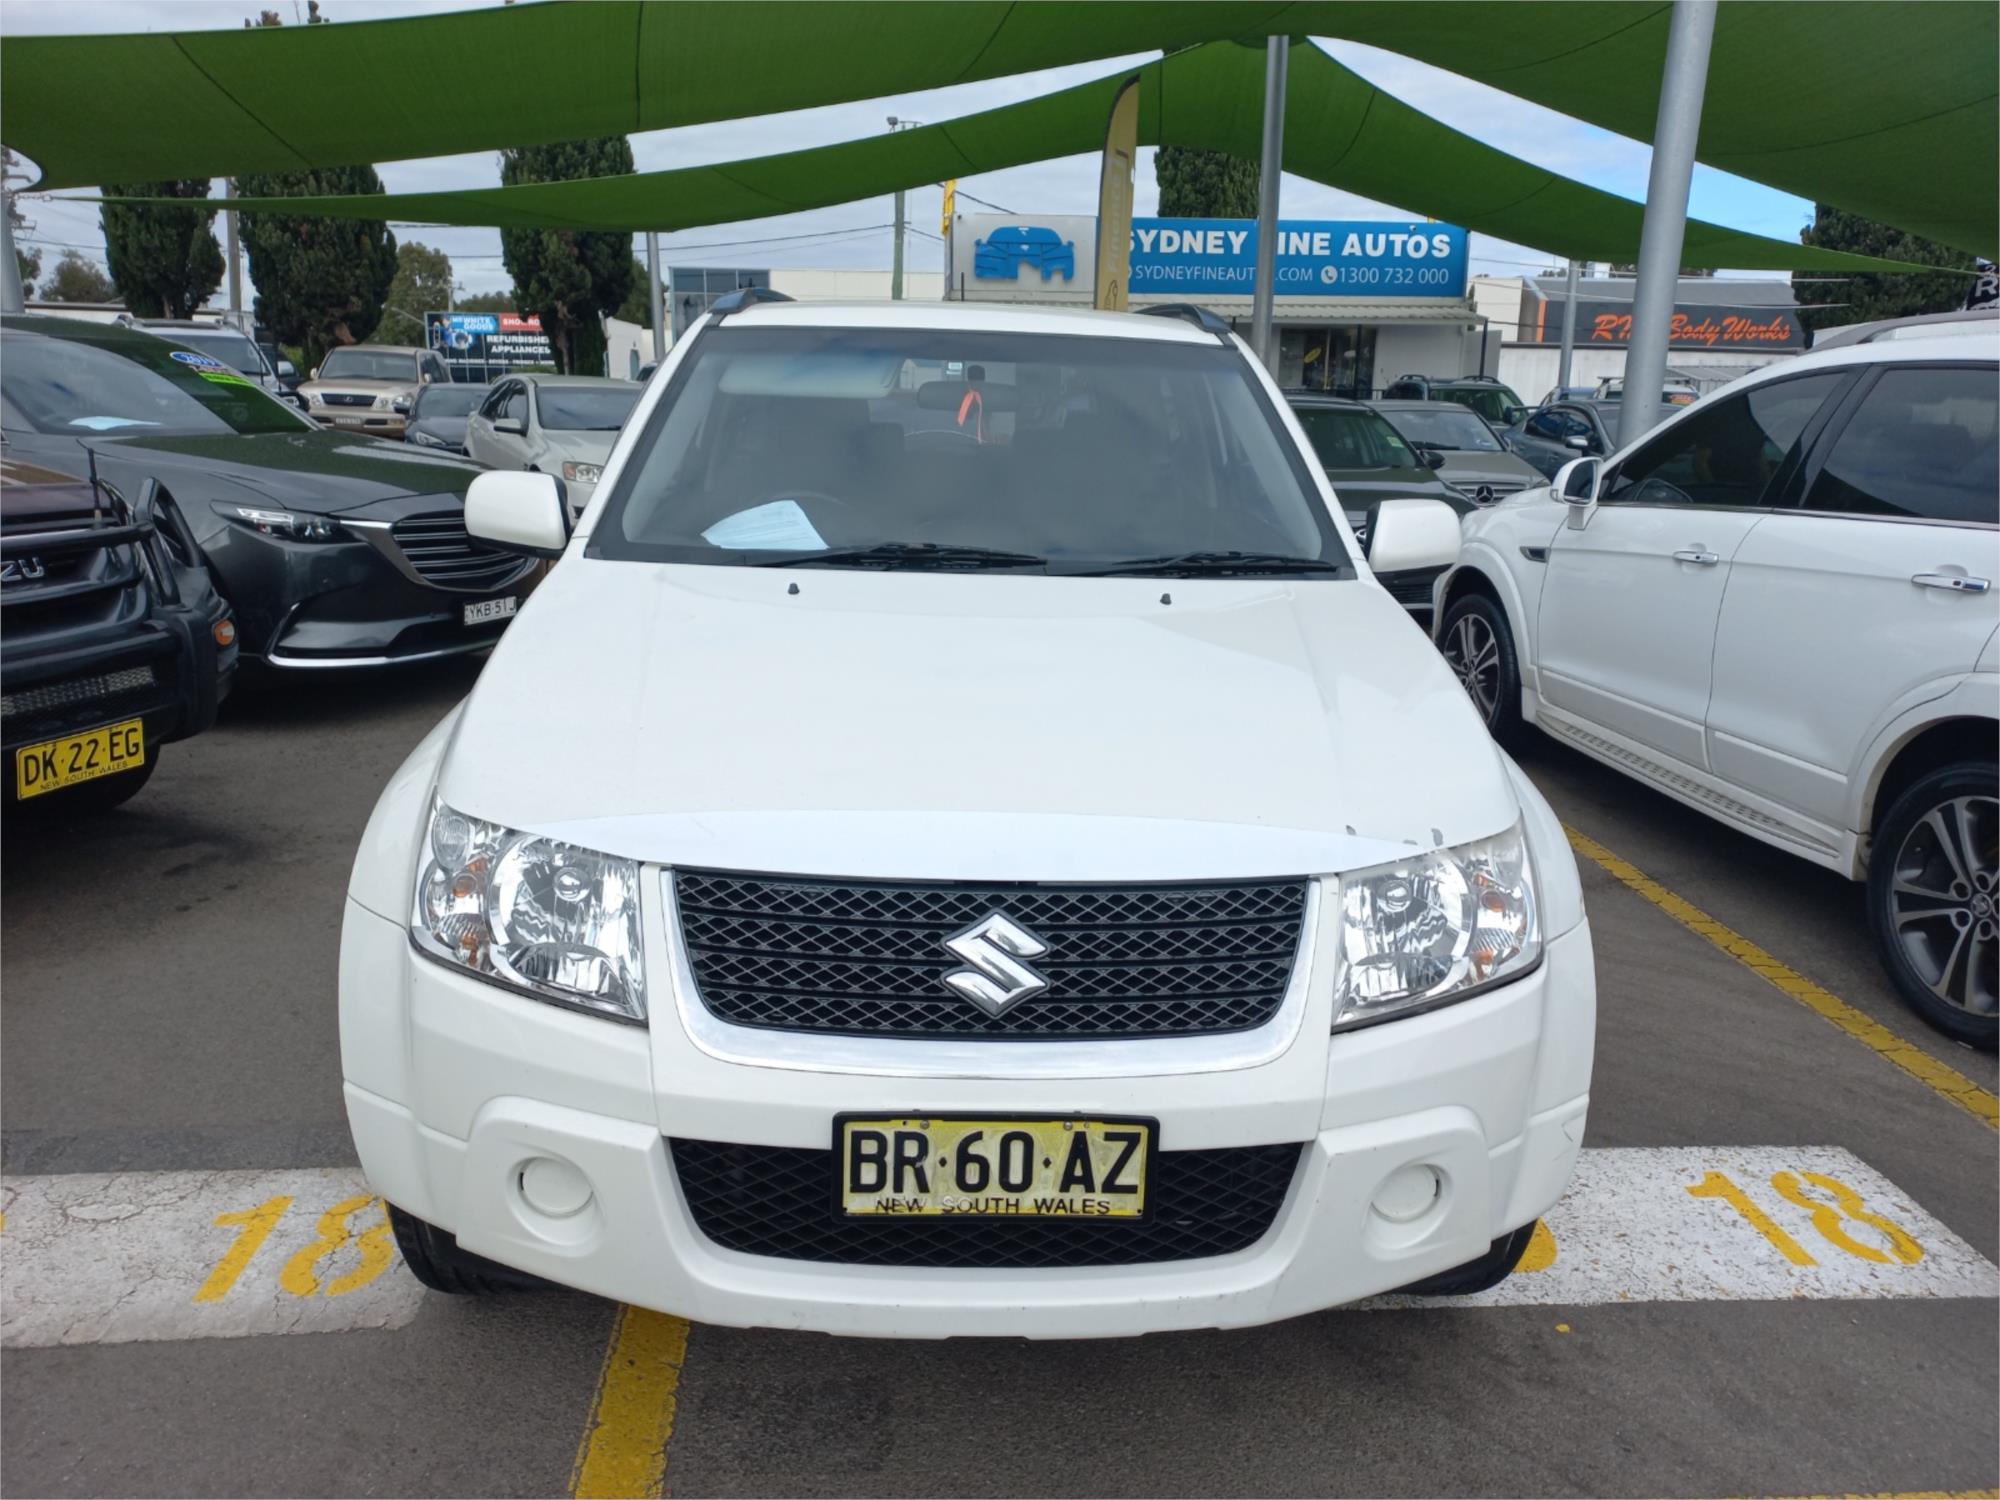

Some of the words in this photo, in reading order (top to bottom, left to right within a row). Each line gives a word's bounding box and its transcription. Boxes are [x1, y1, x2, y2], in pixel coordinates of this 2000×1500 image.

[1130, 229, 1248, 255] YDNEY
[1277, 231, 1331, 256] INE
[1341, 232, 1451, 259] AUTOS
[1135, 265, 1313, 281] SYDNEYFINEAUT.COM
[1339, 267, 1380, 283] 1300
[1384, 267, 1414, 284] 732
[1418, 268, 1449, 284] 000
[1669, 314, 1720, 347] Body
[491, 345, 551, 354] APPLIANCES
[40, 780, 60, 791] NEW
[64, 770, 95, 785] SOUTH
[99, 760, 129, 774] WALES
[875, 1199, 925, 1213] NEW
[942, 1196, 1020, 1214] SOUTH
[1033, 1199, 1110, 1214] WALES
[1685, 1169, 1924, 1268] 18
[192, 1194, 394, 1304] 18
